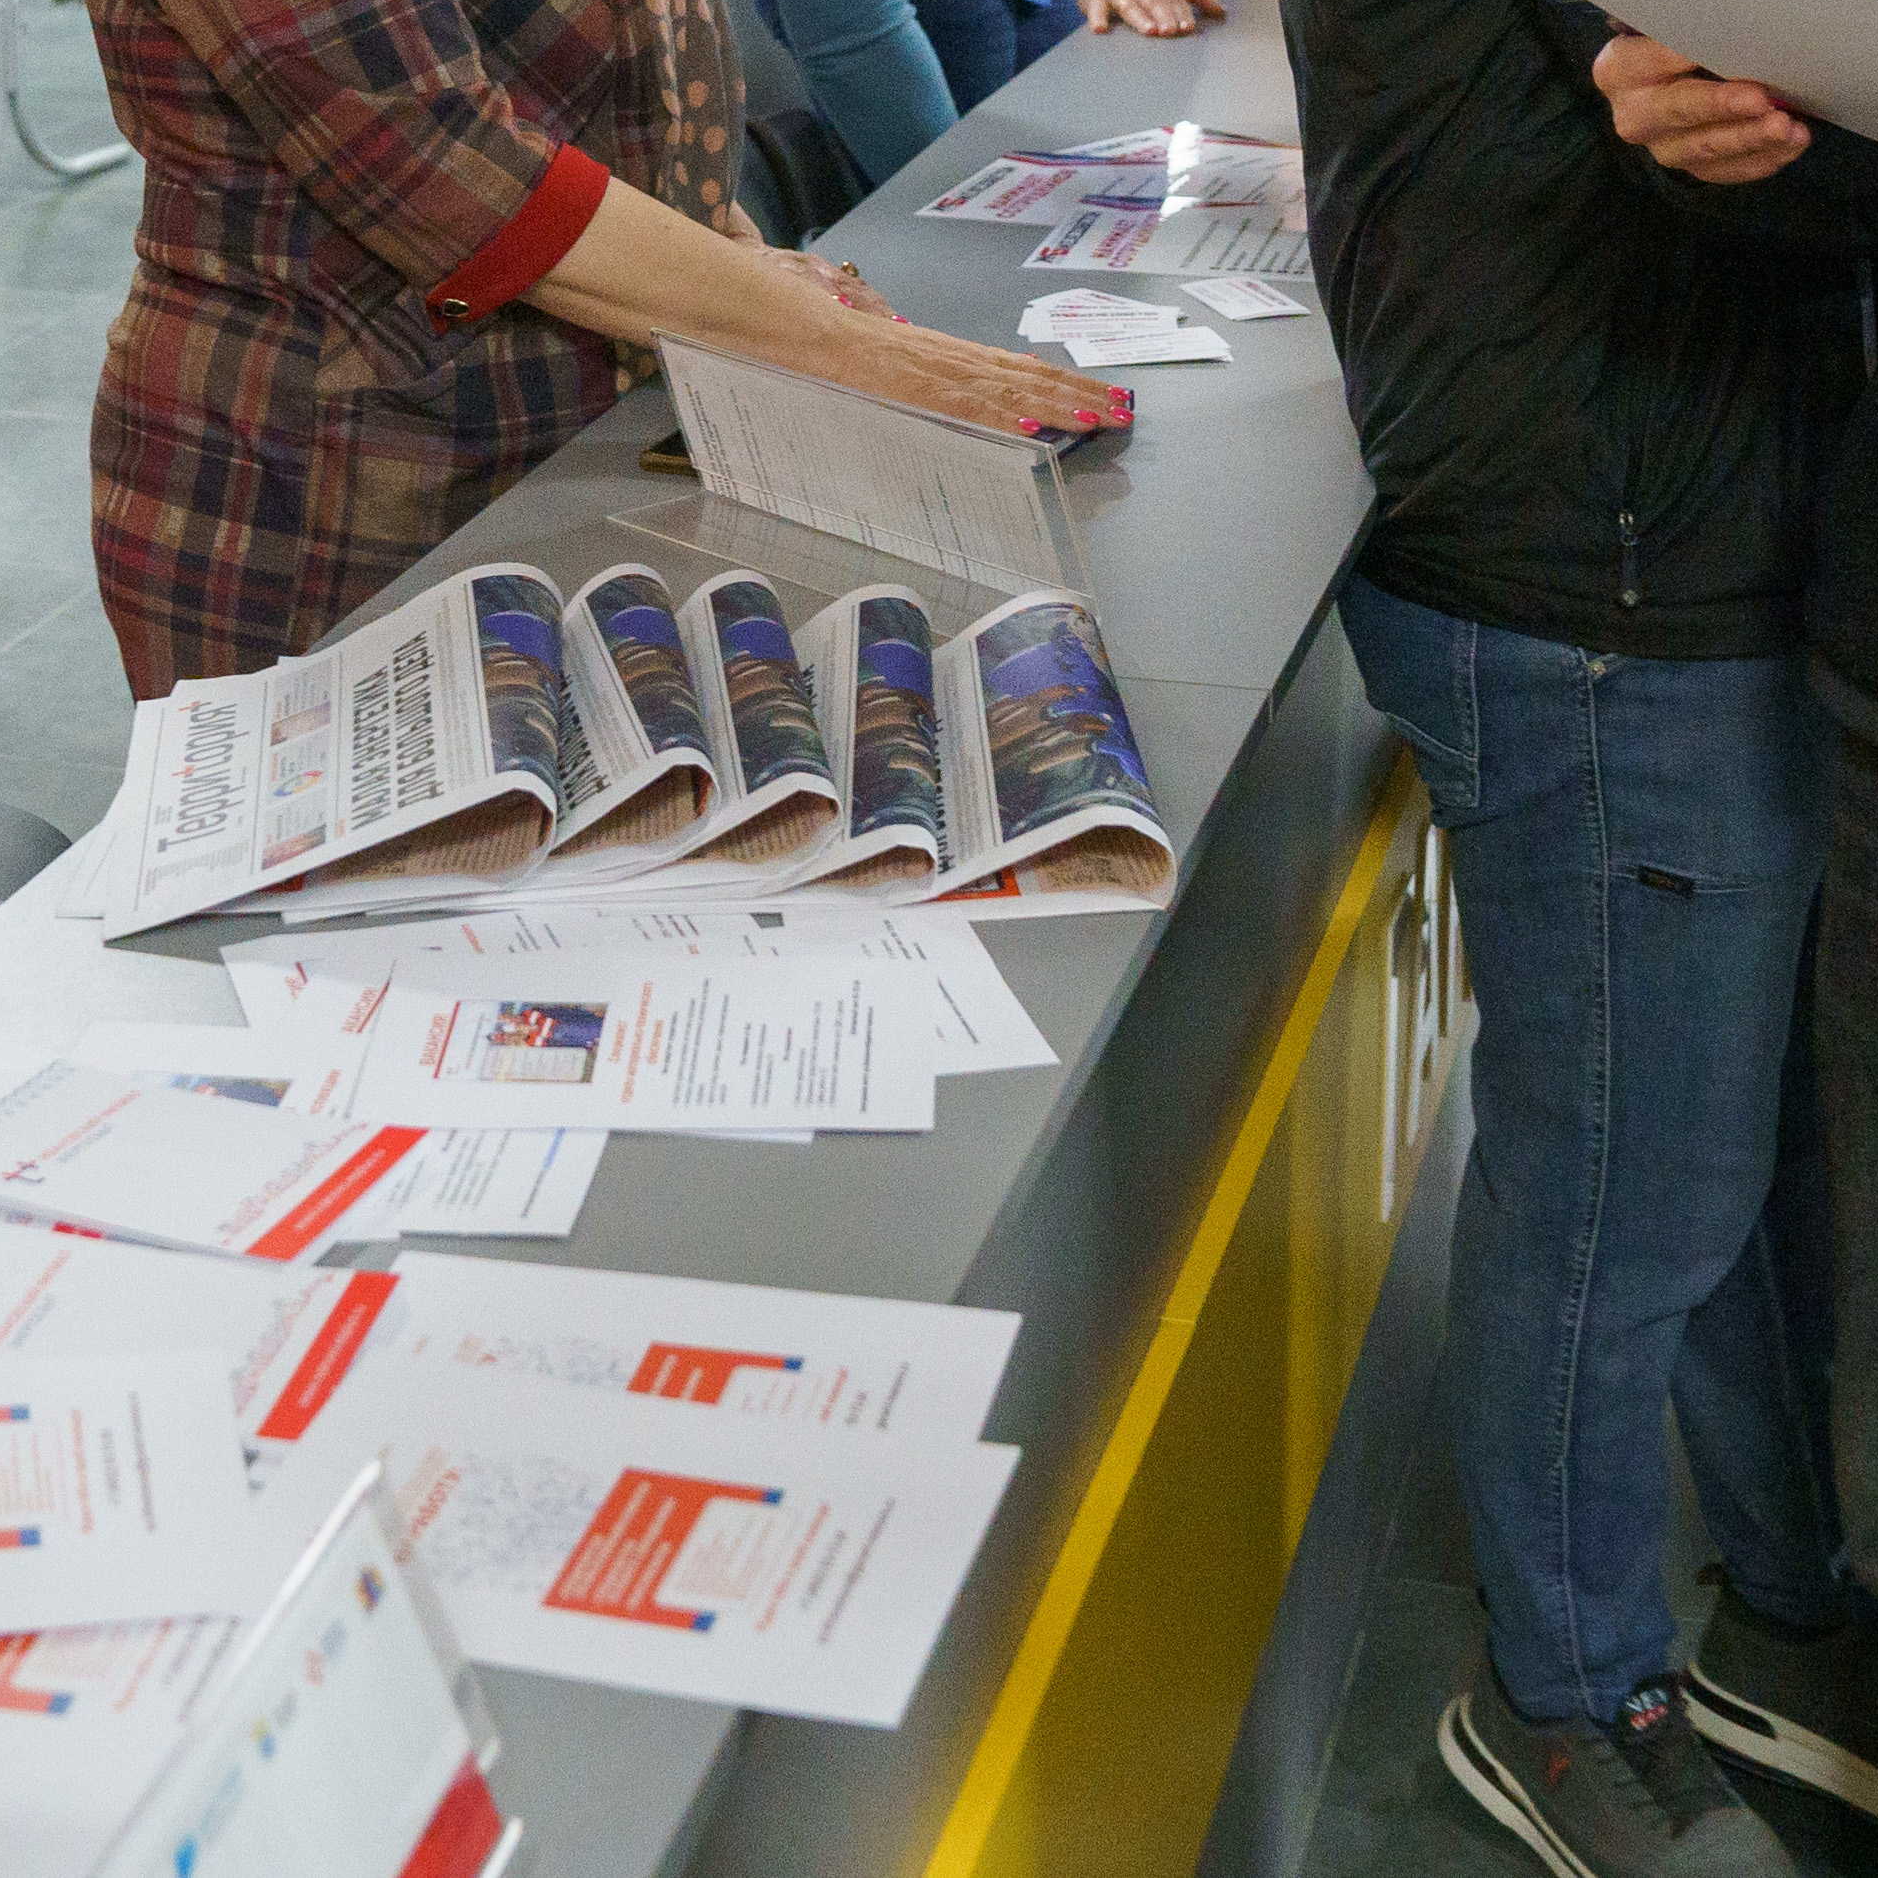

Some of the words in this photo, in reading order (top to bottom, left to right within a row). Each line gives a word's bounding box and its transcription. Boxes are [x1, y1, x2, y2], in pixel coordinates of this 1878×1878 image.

[392, 630, 436, 683] ДЕЛА
[352, 665, 391, 770] ЭНЕРГЕТИКА
[393, 673, 435, 771] БОЛЬШОГО
[351, 760, 391, 831] МАЛАЯ
[397, 762, 445, 809] ДЛЯ
